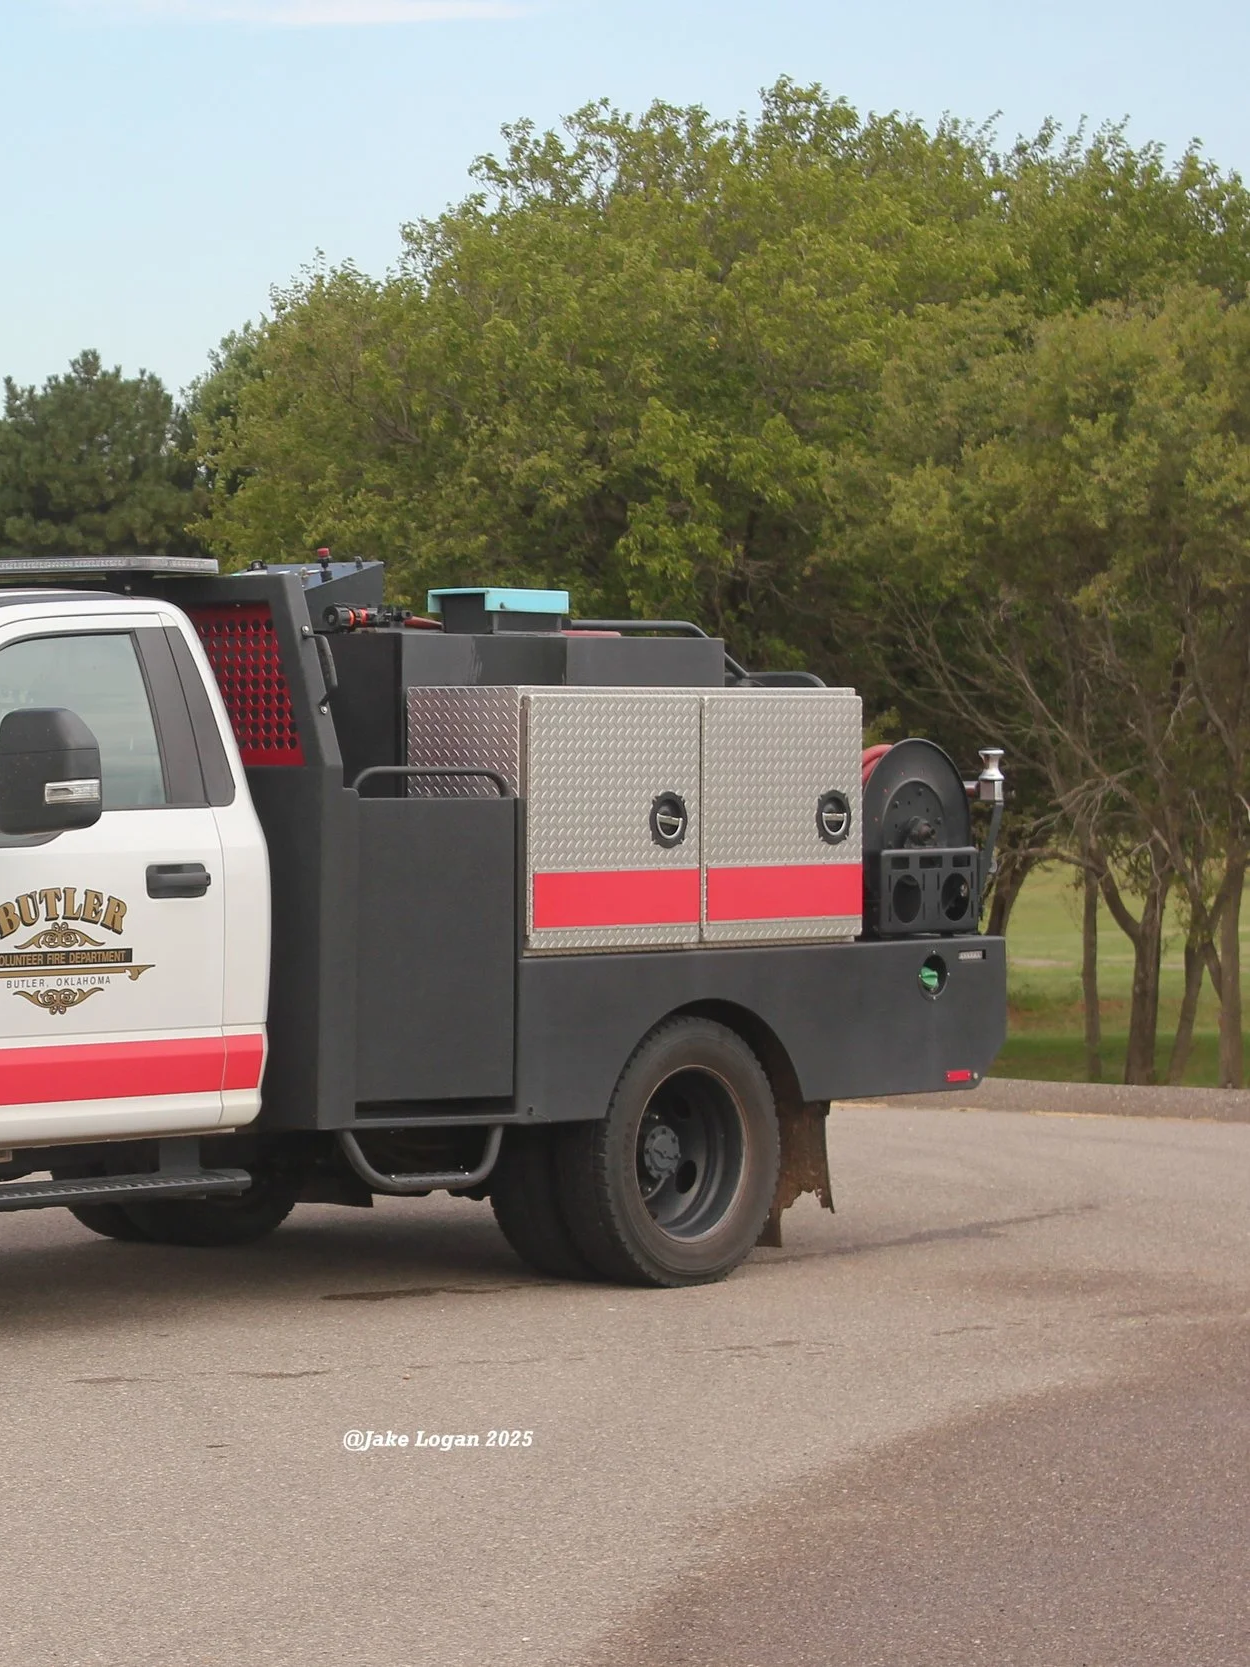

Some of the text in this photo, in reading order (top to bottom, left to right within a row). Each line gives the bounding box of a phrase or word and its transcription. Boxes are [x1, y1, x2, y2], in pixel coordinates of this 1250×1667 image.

[47, 952, 66, 965] FIRE
[69, 950, 127, 964] DEPARTMENT
[6, 976, 111, 989] BUTLER, OKLAHOMA
